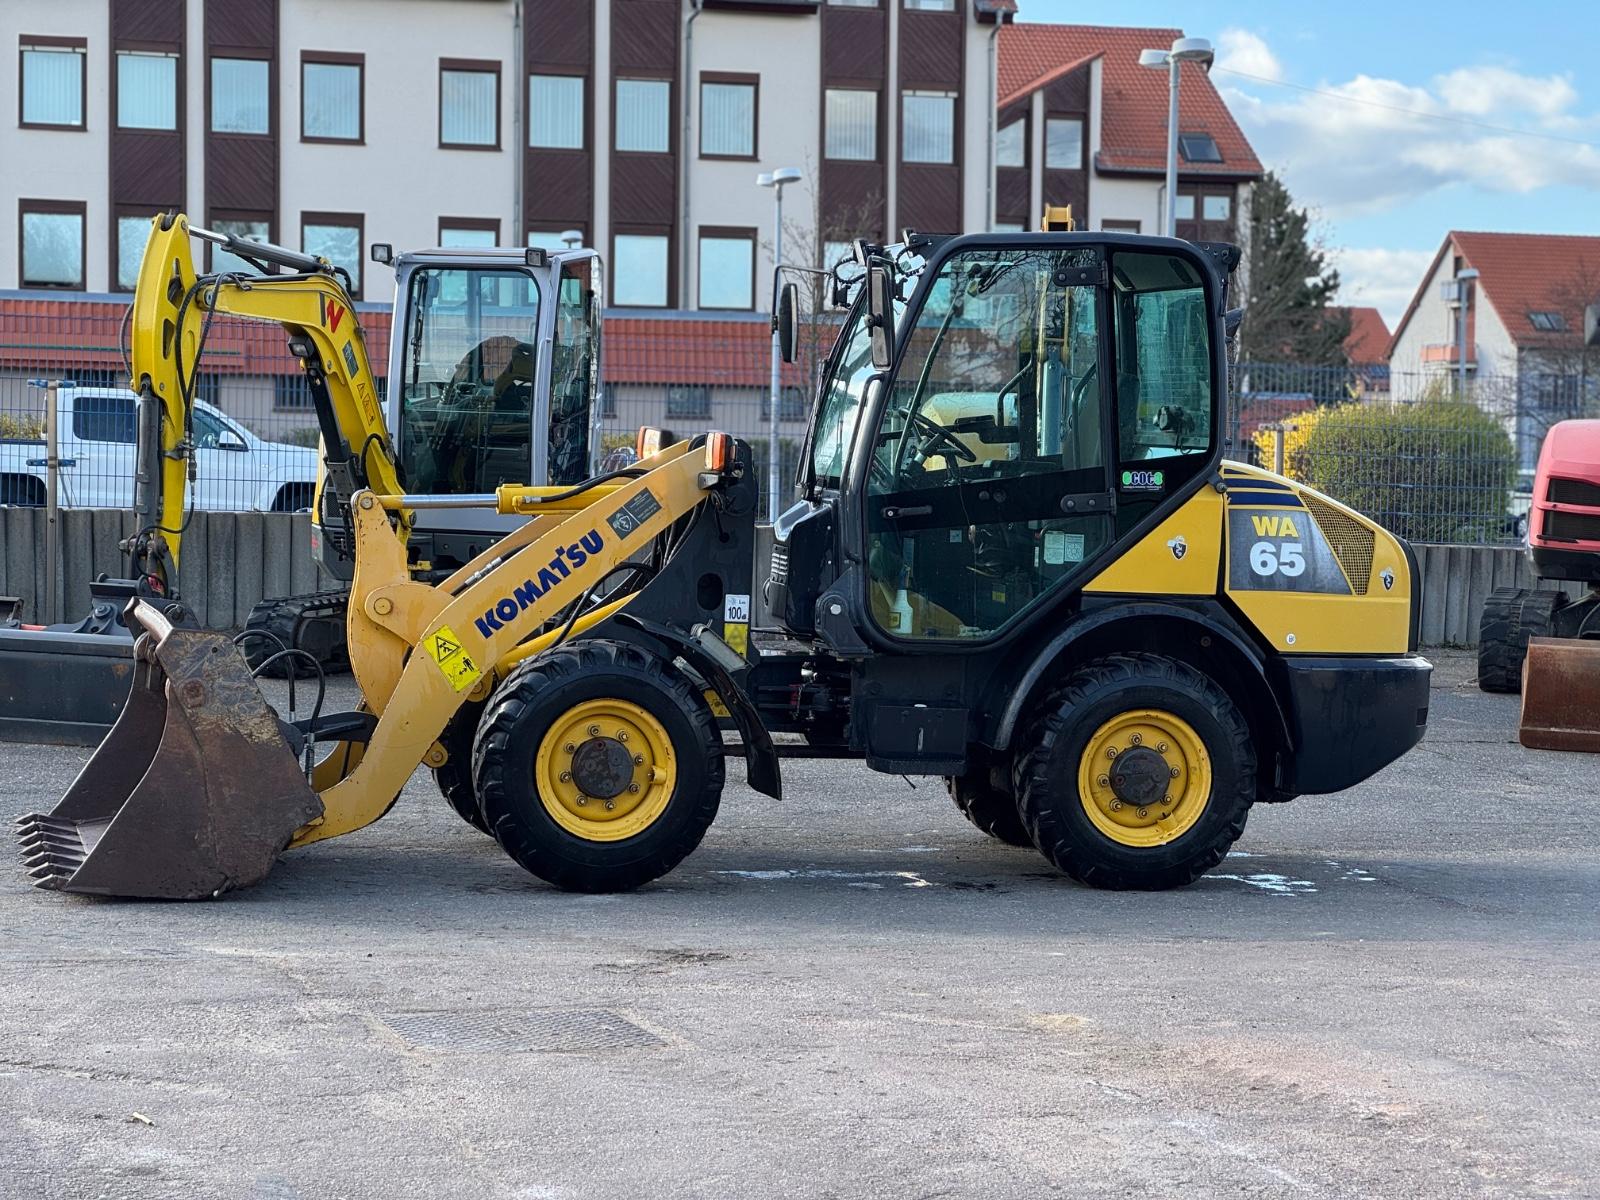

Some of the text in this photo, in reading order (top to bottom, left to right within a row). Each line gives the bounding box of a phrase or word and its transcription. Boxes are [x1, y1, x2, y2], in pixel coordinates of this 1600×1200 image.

[1251, 515, 1299, 538] WA
[1249, 541, 1306, 577] 65
[474, 528, 604, 639] KOMATSU
[728, 606, 741, 620] 100
